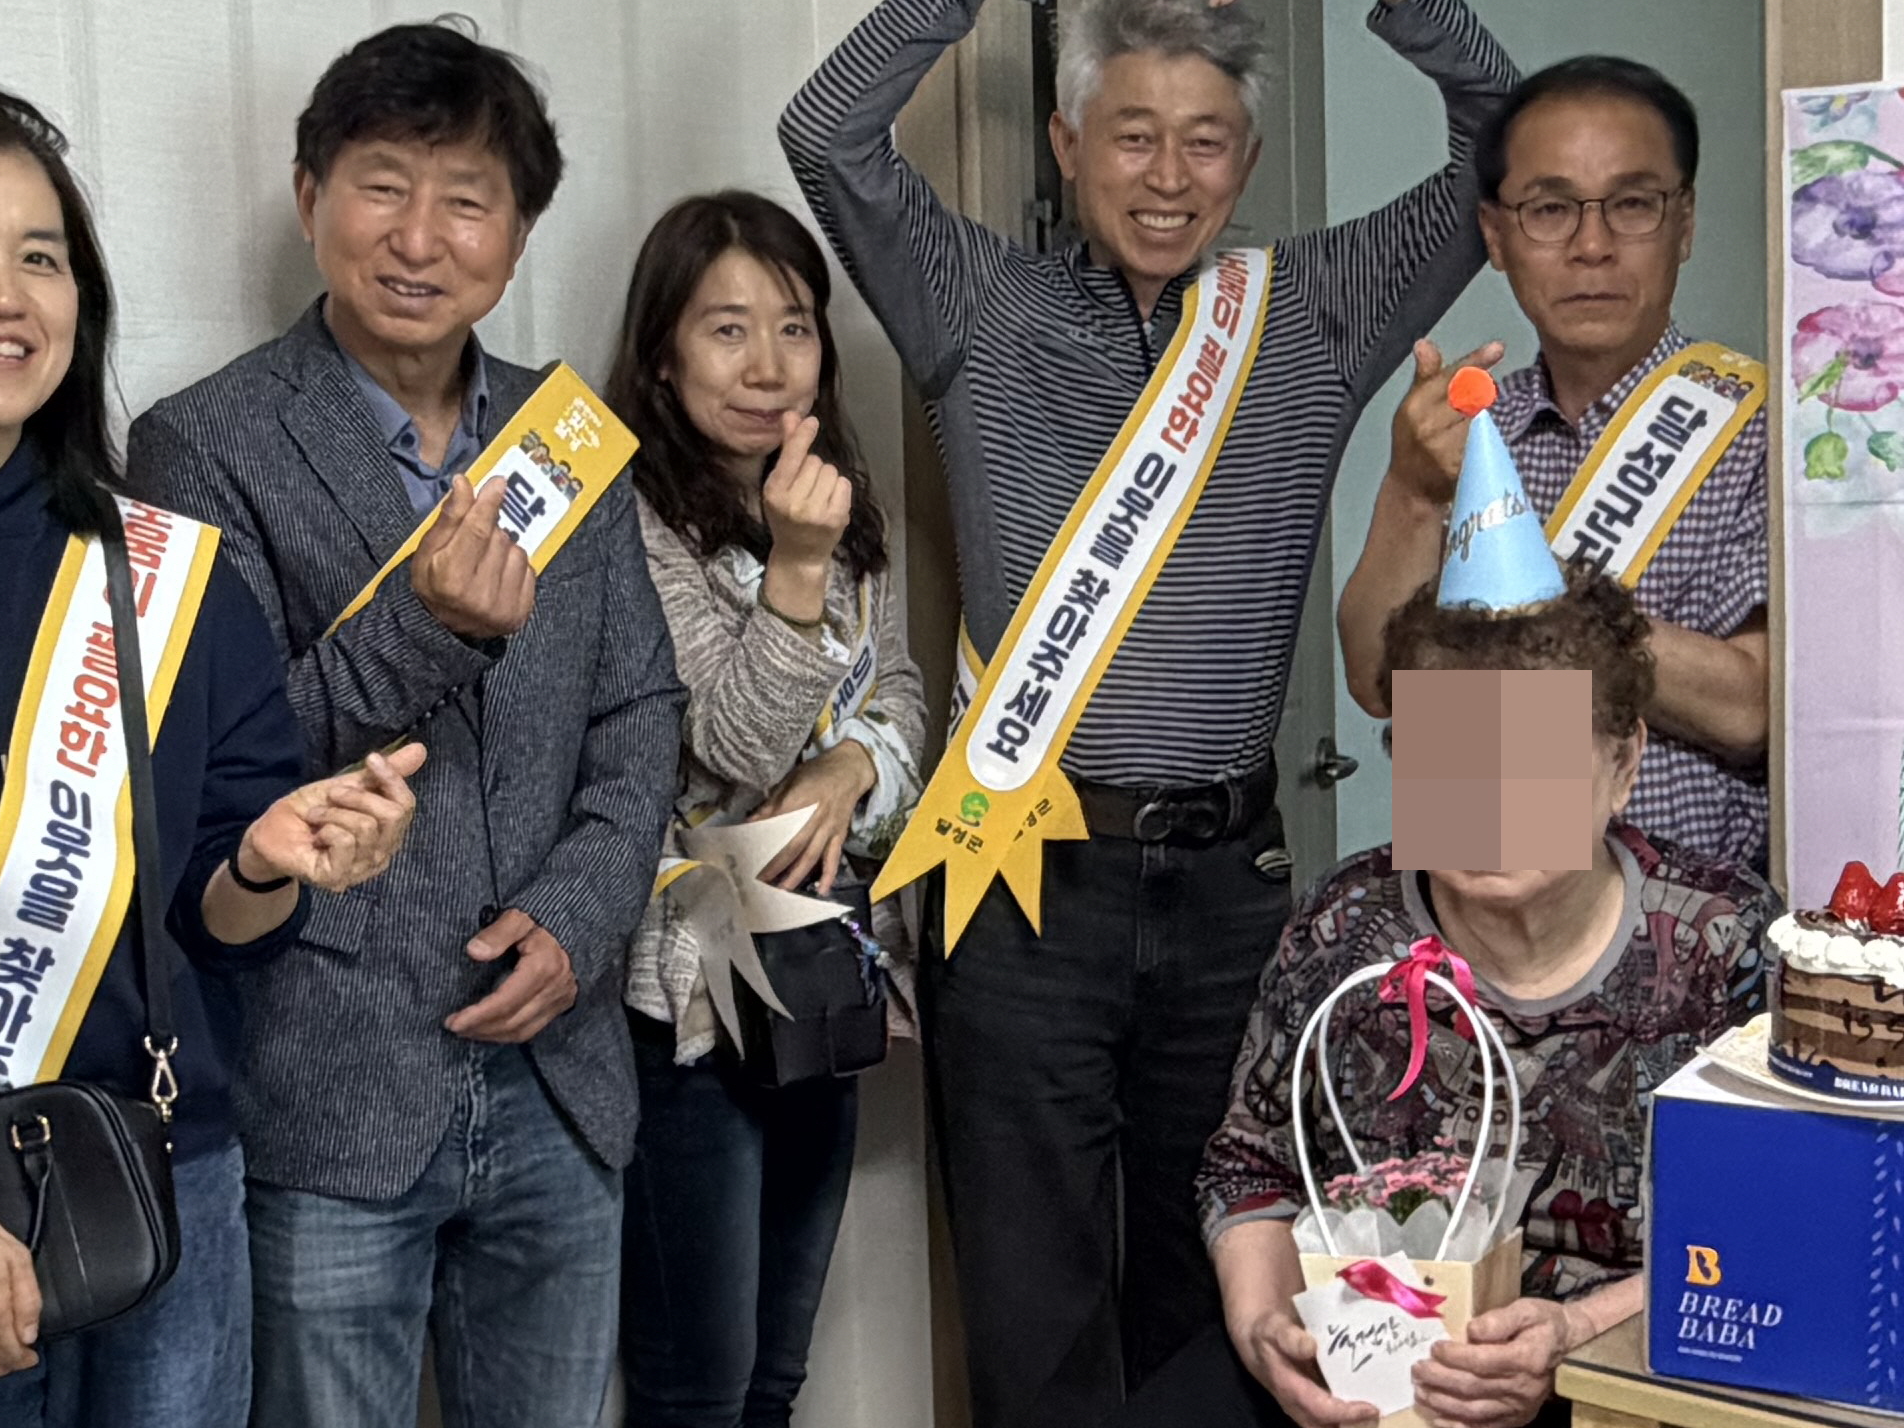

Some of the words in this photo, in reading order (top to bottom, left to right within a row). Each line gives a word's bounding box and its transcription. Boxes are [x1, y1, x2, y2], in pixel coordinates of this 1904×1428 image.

[1162, 334, 1229, 454] 필요한
[1090, 450, 1177, 572] 이웃을
[988, 567, 1113, 763] 찾아주세요
[17, 779, 93, 934] 이웃을
[933, 814, 986, 855] 달성군
[1678, 1291, 1783, 1327] BREAD
[1678, 1316, 1756, 1350] BABA
